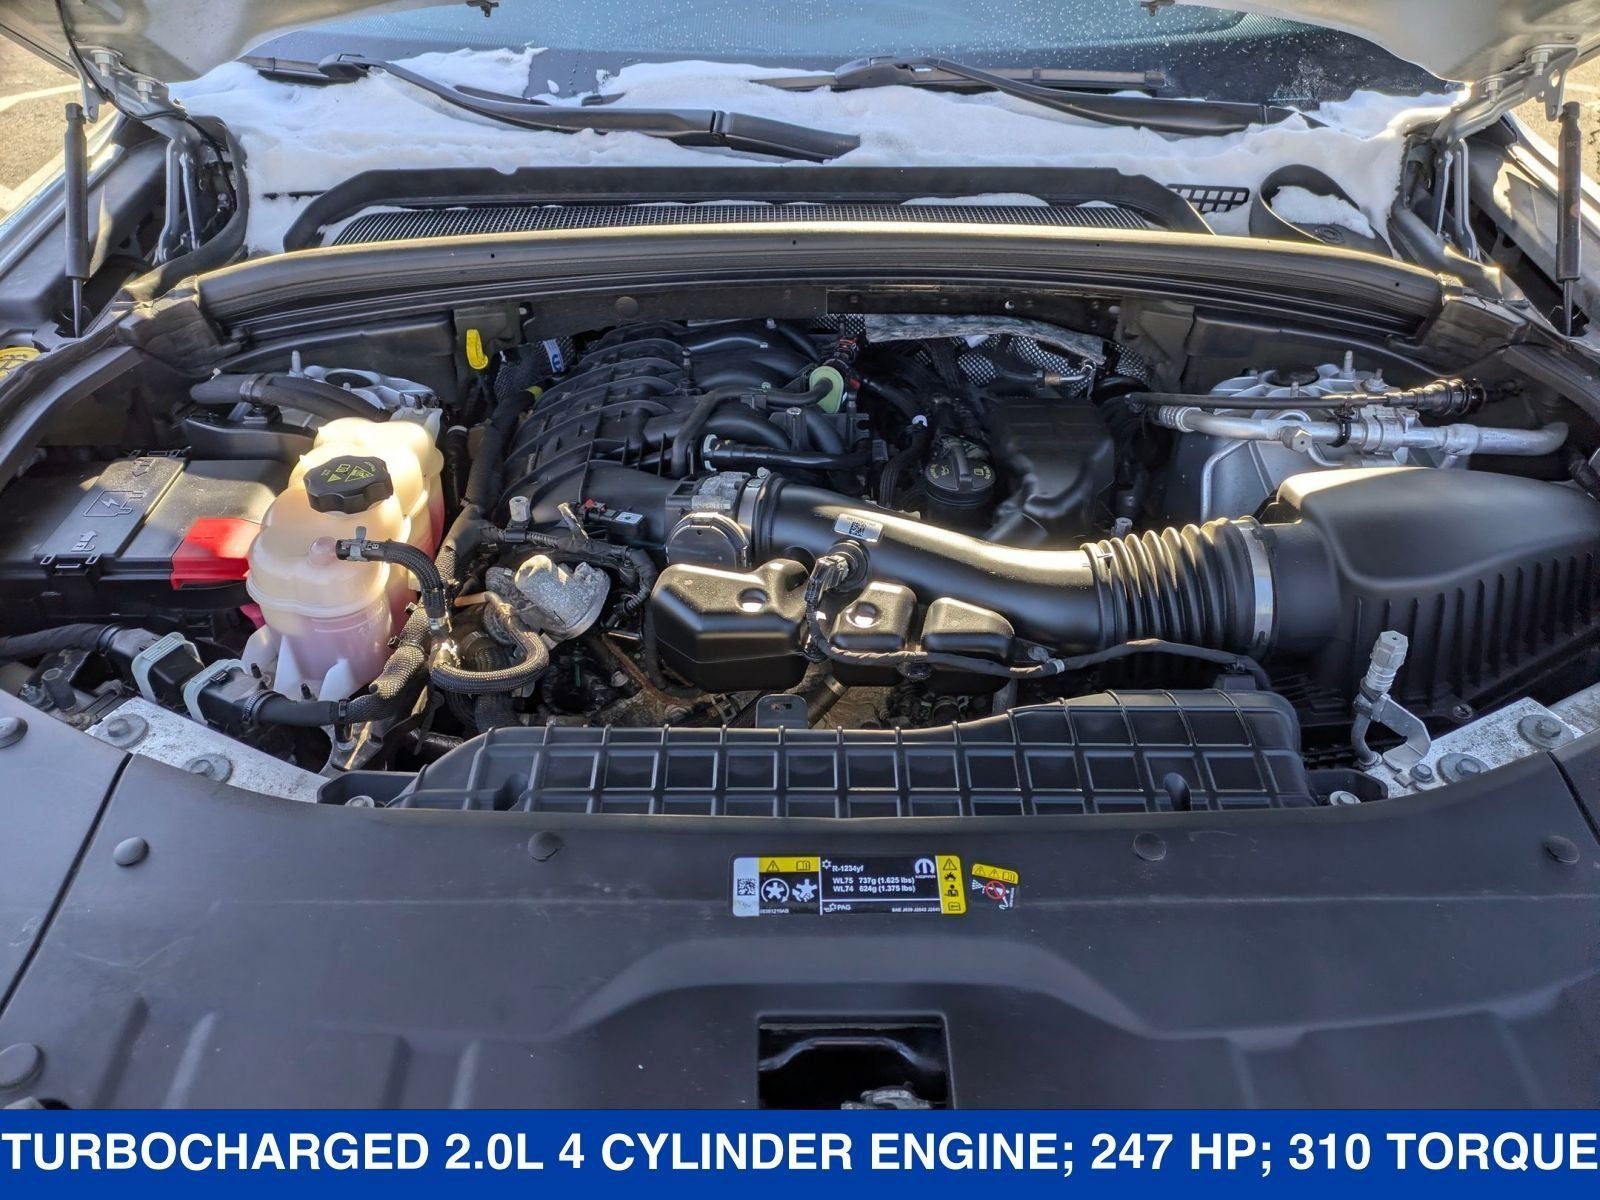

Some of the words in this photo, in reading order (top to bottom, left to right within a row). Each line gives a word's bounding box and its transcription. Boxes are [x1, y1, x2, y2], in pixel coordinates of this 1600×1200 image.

[832, 865, 864, 873] R-1234yf
[859, 877, 876, 885] 737g
[878, 877, 900, 885] (1.625
[859, 885, 877, 893] 624g
[878, 885, 900, 893] (1.375
[901, 885, 915, 893] lbs)
